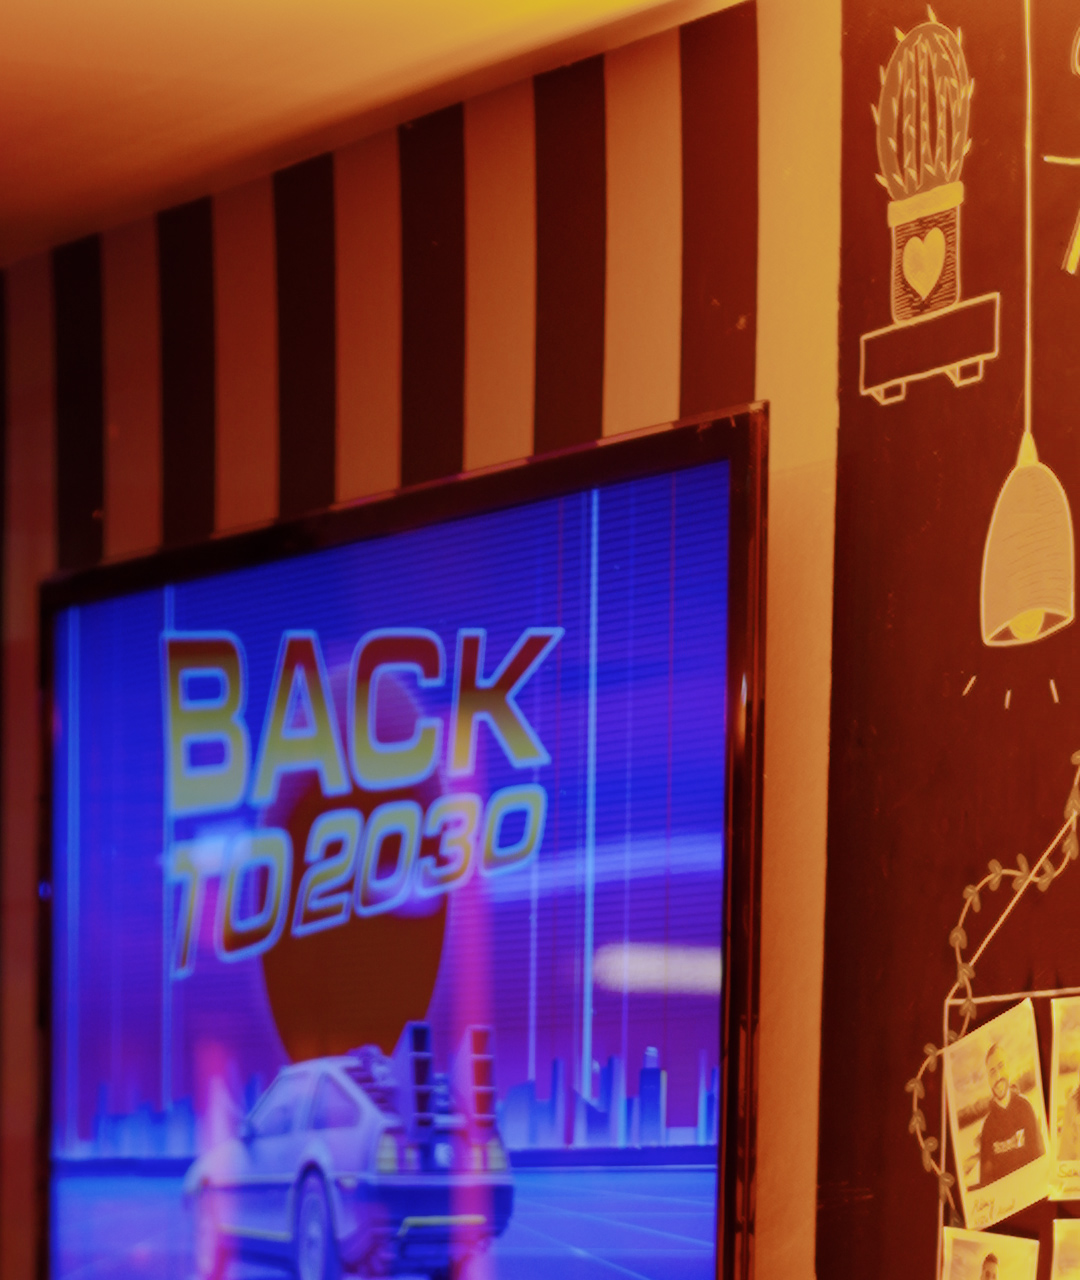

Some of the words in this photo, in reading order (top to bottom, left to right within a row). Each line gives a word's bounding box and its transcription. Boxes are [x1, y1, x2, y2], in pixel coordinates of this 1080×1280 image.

[159, 627, 566, 818] BACK
[168, 826, 294, 981] TO
[291, 783, 548, 938] 2030
